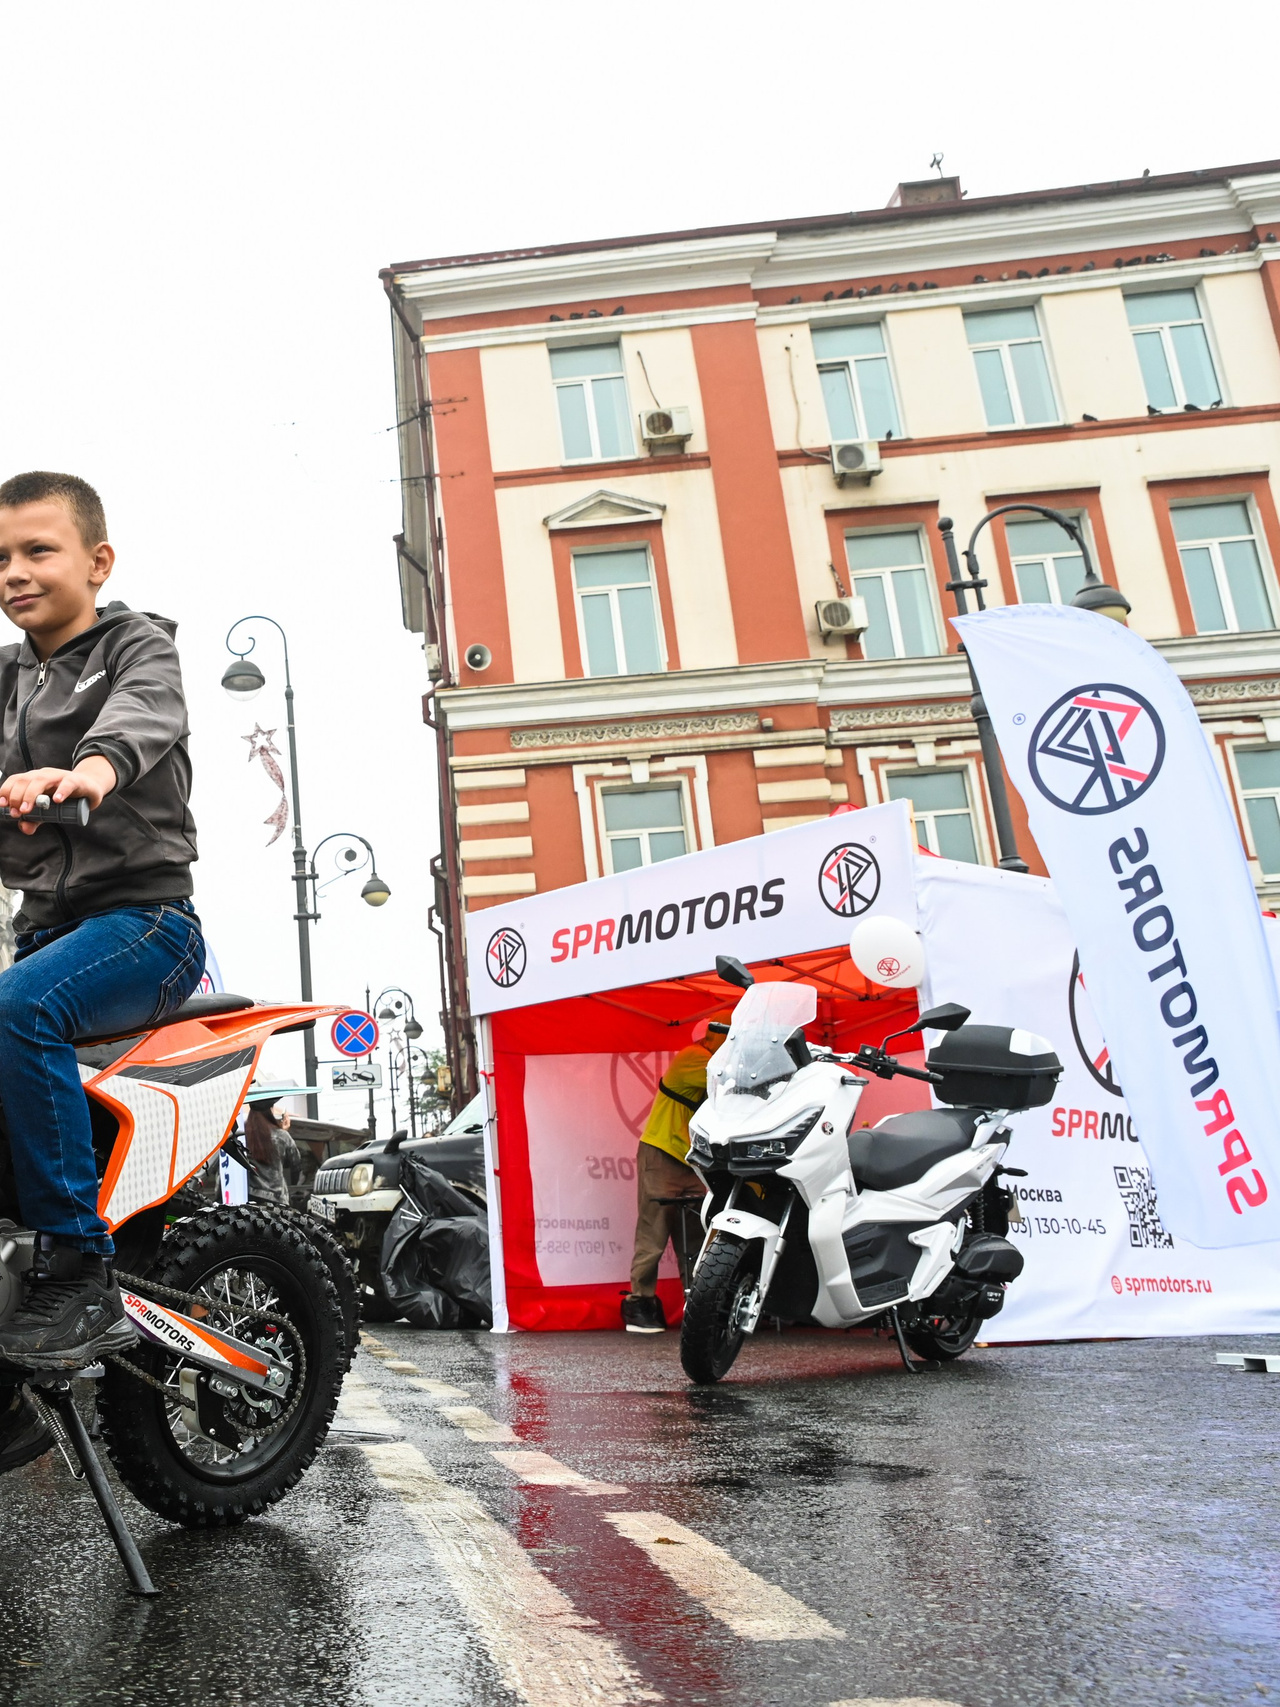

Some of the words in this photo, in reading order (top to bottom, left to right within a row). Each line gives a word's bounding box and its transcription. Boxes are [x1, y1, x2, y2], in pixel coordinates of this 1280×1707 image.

[550, 877, 785, 963] SPRMOTORS
[1006, 1183, 1063, 1203] Москва
[1035, 1217, 1107, 1235] 130-10-45
[1125, 1276, 1213, 1296] sprmotors.ru
[124, 1294, 196, 1352] SPRMOTORS
